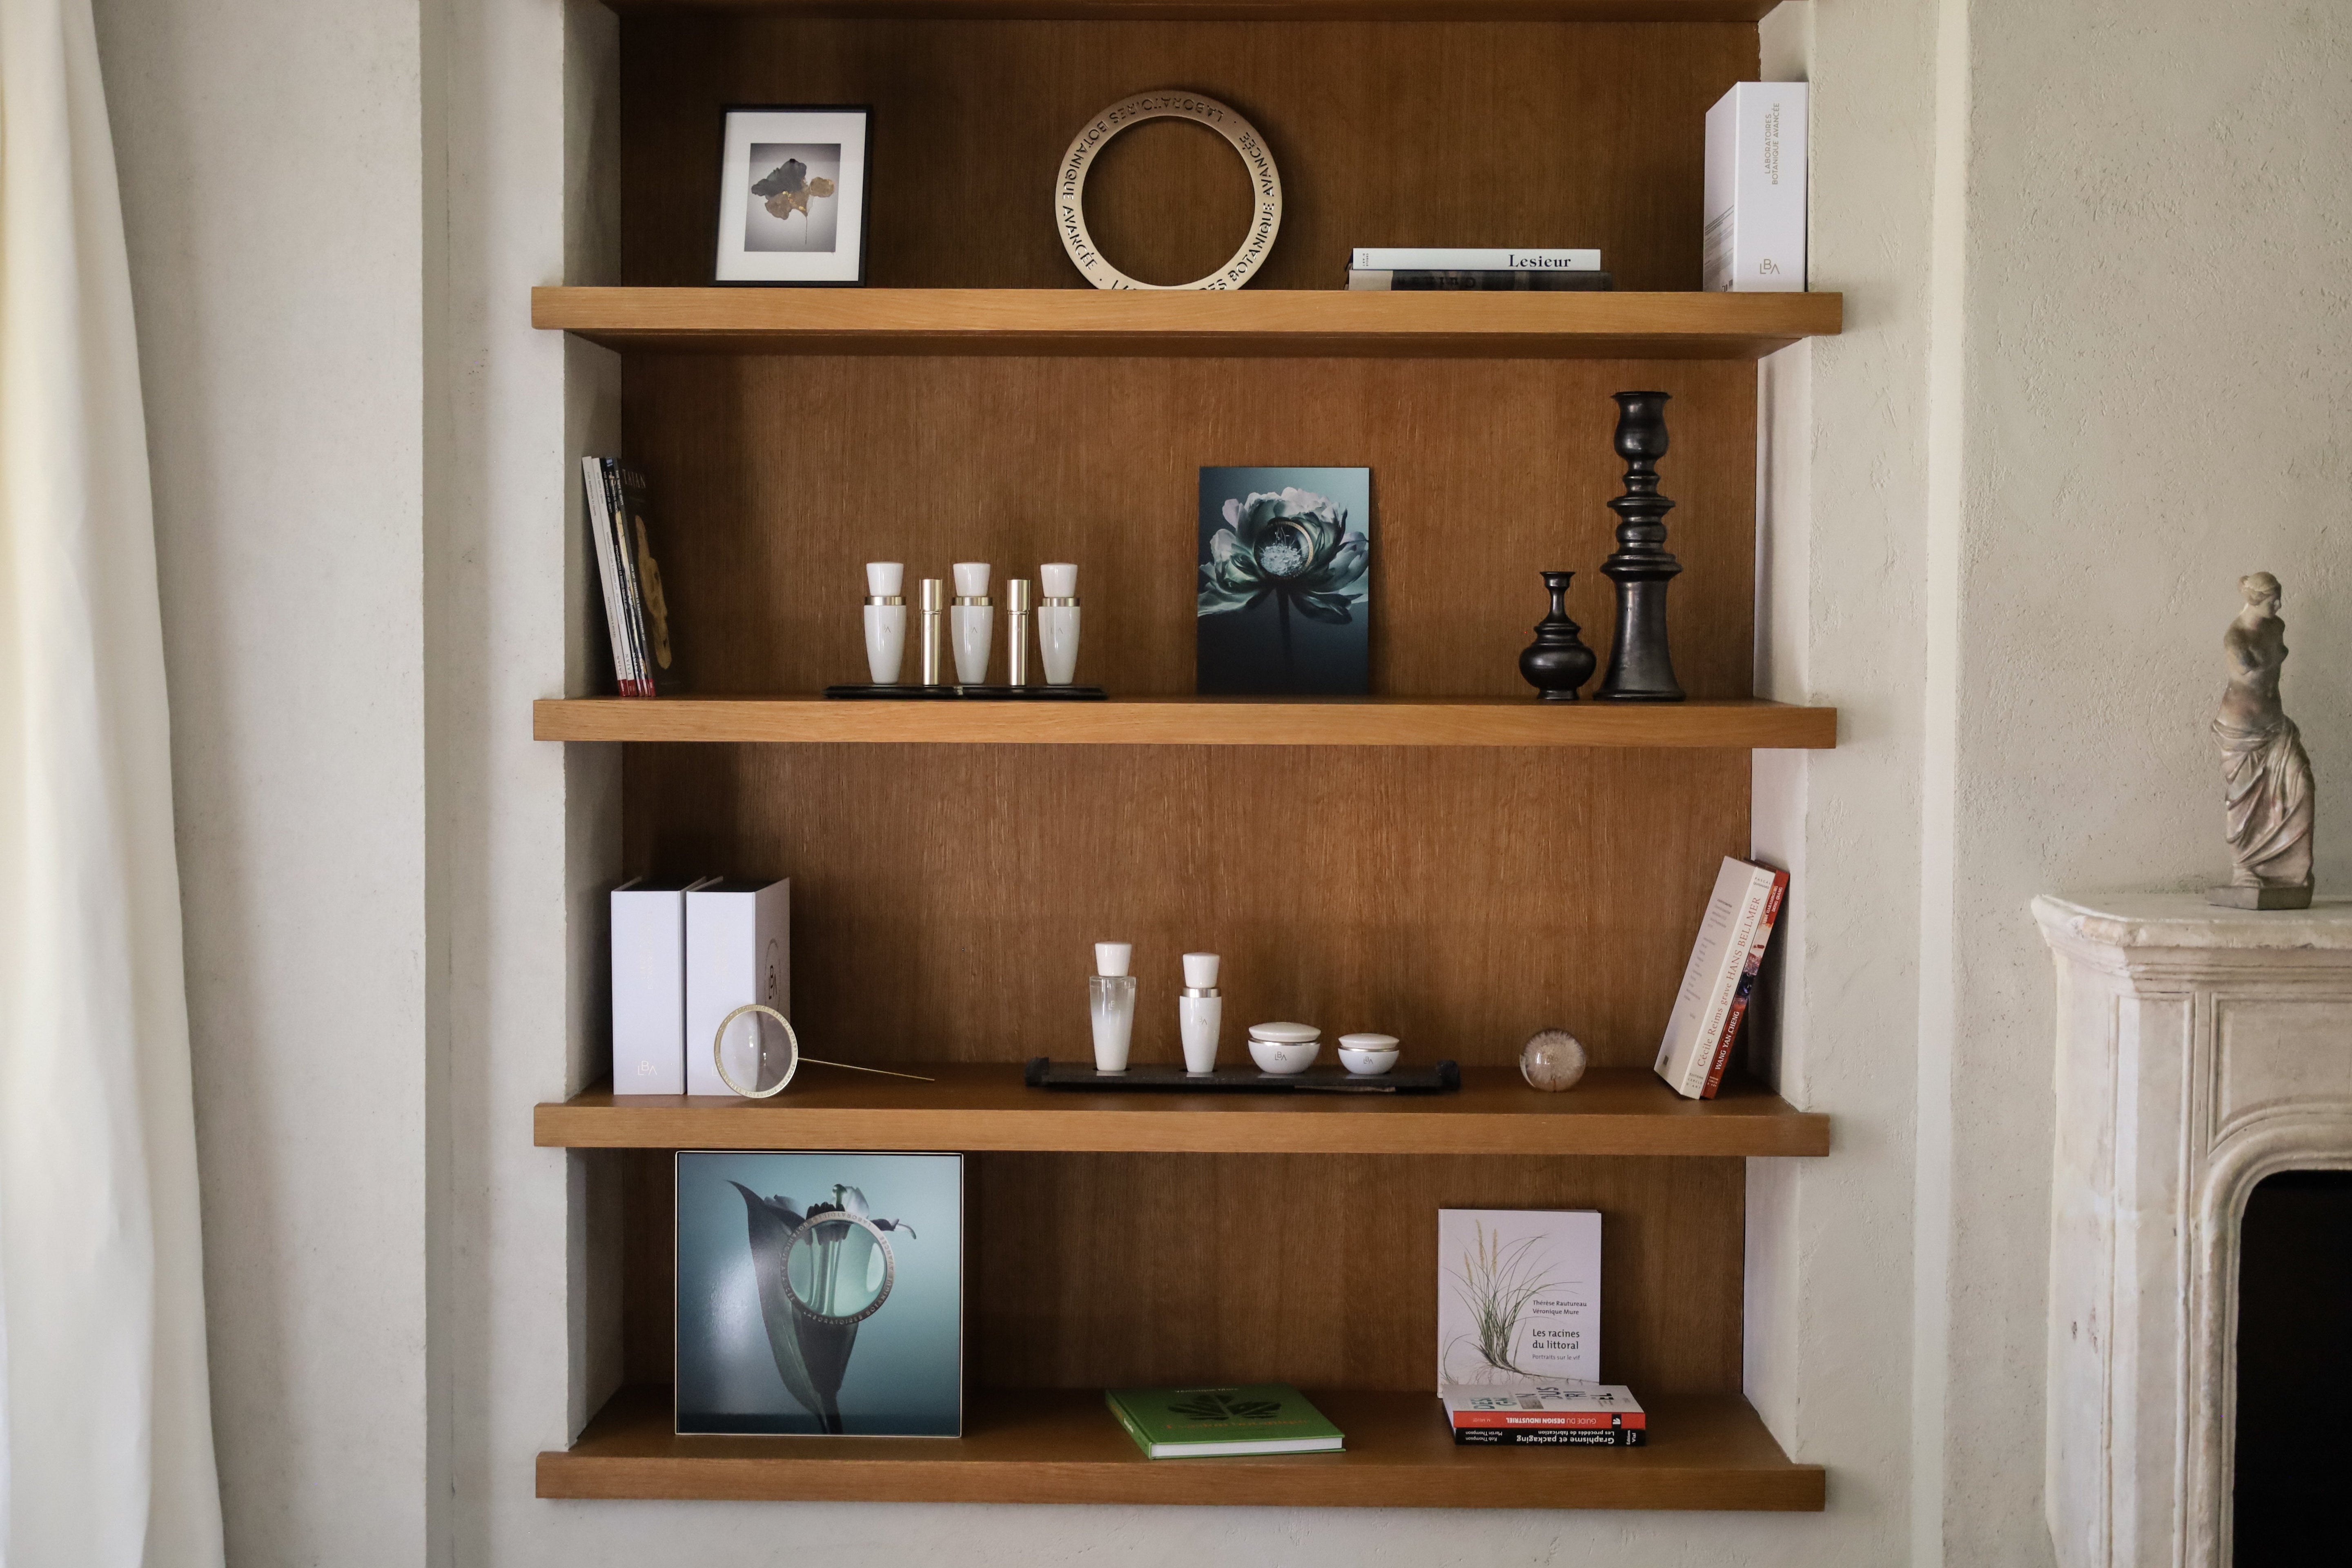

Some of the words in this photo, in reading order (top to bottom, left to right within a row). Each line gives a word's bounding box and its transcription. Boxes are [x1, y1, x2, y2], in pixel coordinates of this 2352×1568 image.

[1109, 97, 1223, 124] LABORATOIRES
[1062, 120, 1109, 200] BOTANIQUE
[1239, 132, 1274, 197] AVANCÉE
[1062, 205, 1097, 271] AVANCÉE
[1227, 202, 1274, 282] BOTANIQUE
[1508, 254, 1571, 267] Lesieur
[1760, 259, 1780, 274] LBA
[1697, 1038, 1713, 1067] Cécile
[1708, 1008, 1723, 1036] Reims
[1721, 983, 1731, 1005] grave
[1726, 950, 1742, 980] HANS
[1737, 898, 1761, 947] BELLMER
[1715, 1050, 1726, 1070] WANG
[1722, 1034, 1732, 1048] YAN
[1728, 1011, 1740, 1033] CHENG
[1275, 1051, 1287, 1061] LBA
[803, 1310, 863, 1325] LABORATOIRES
[1532, 1329, 1546, 1337] Les
[1548, 1329, 1580, 1338] racines
[1532, 1340, 1544, 1349] du
[1547, 1340, 1579, 1350] littoral
[1517, 1435, 1557, 1443] packaging
[1570, 1436, 1615, 1444] Graphisme
